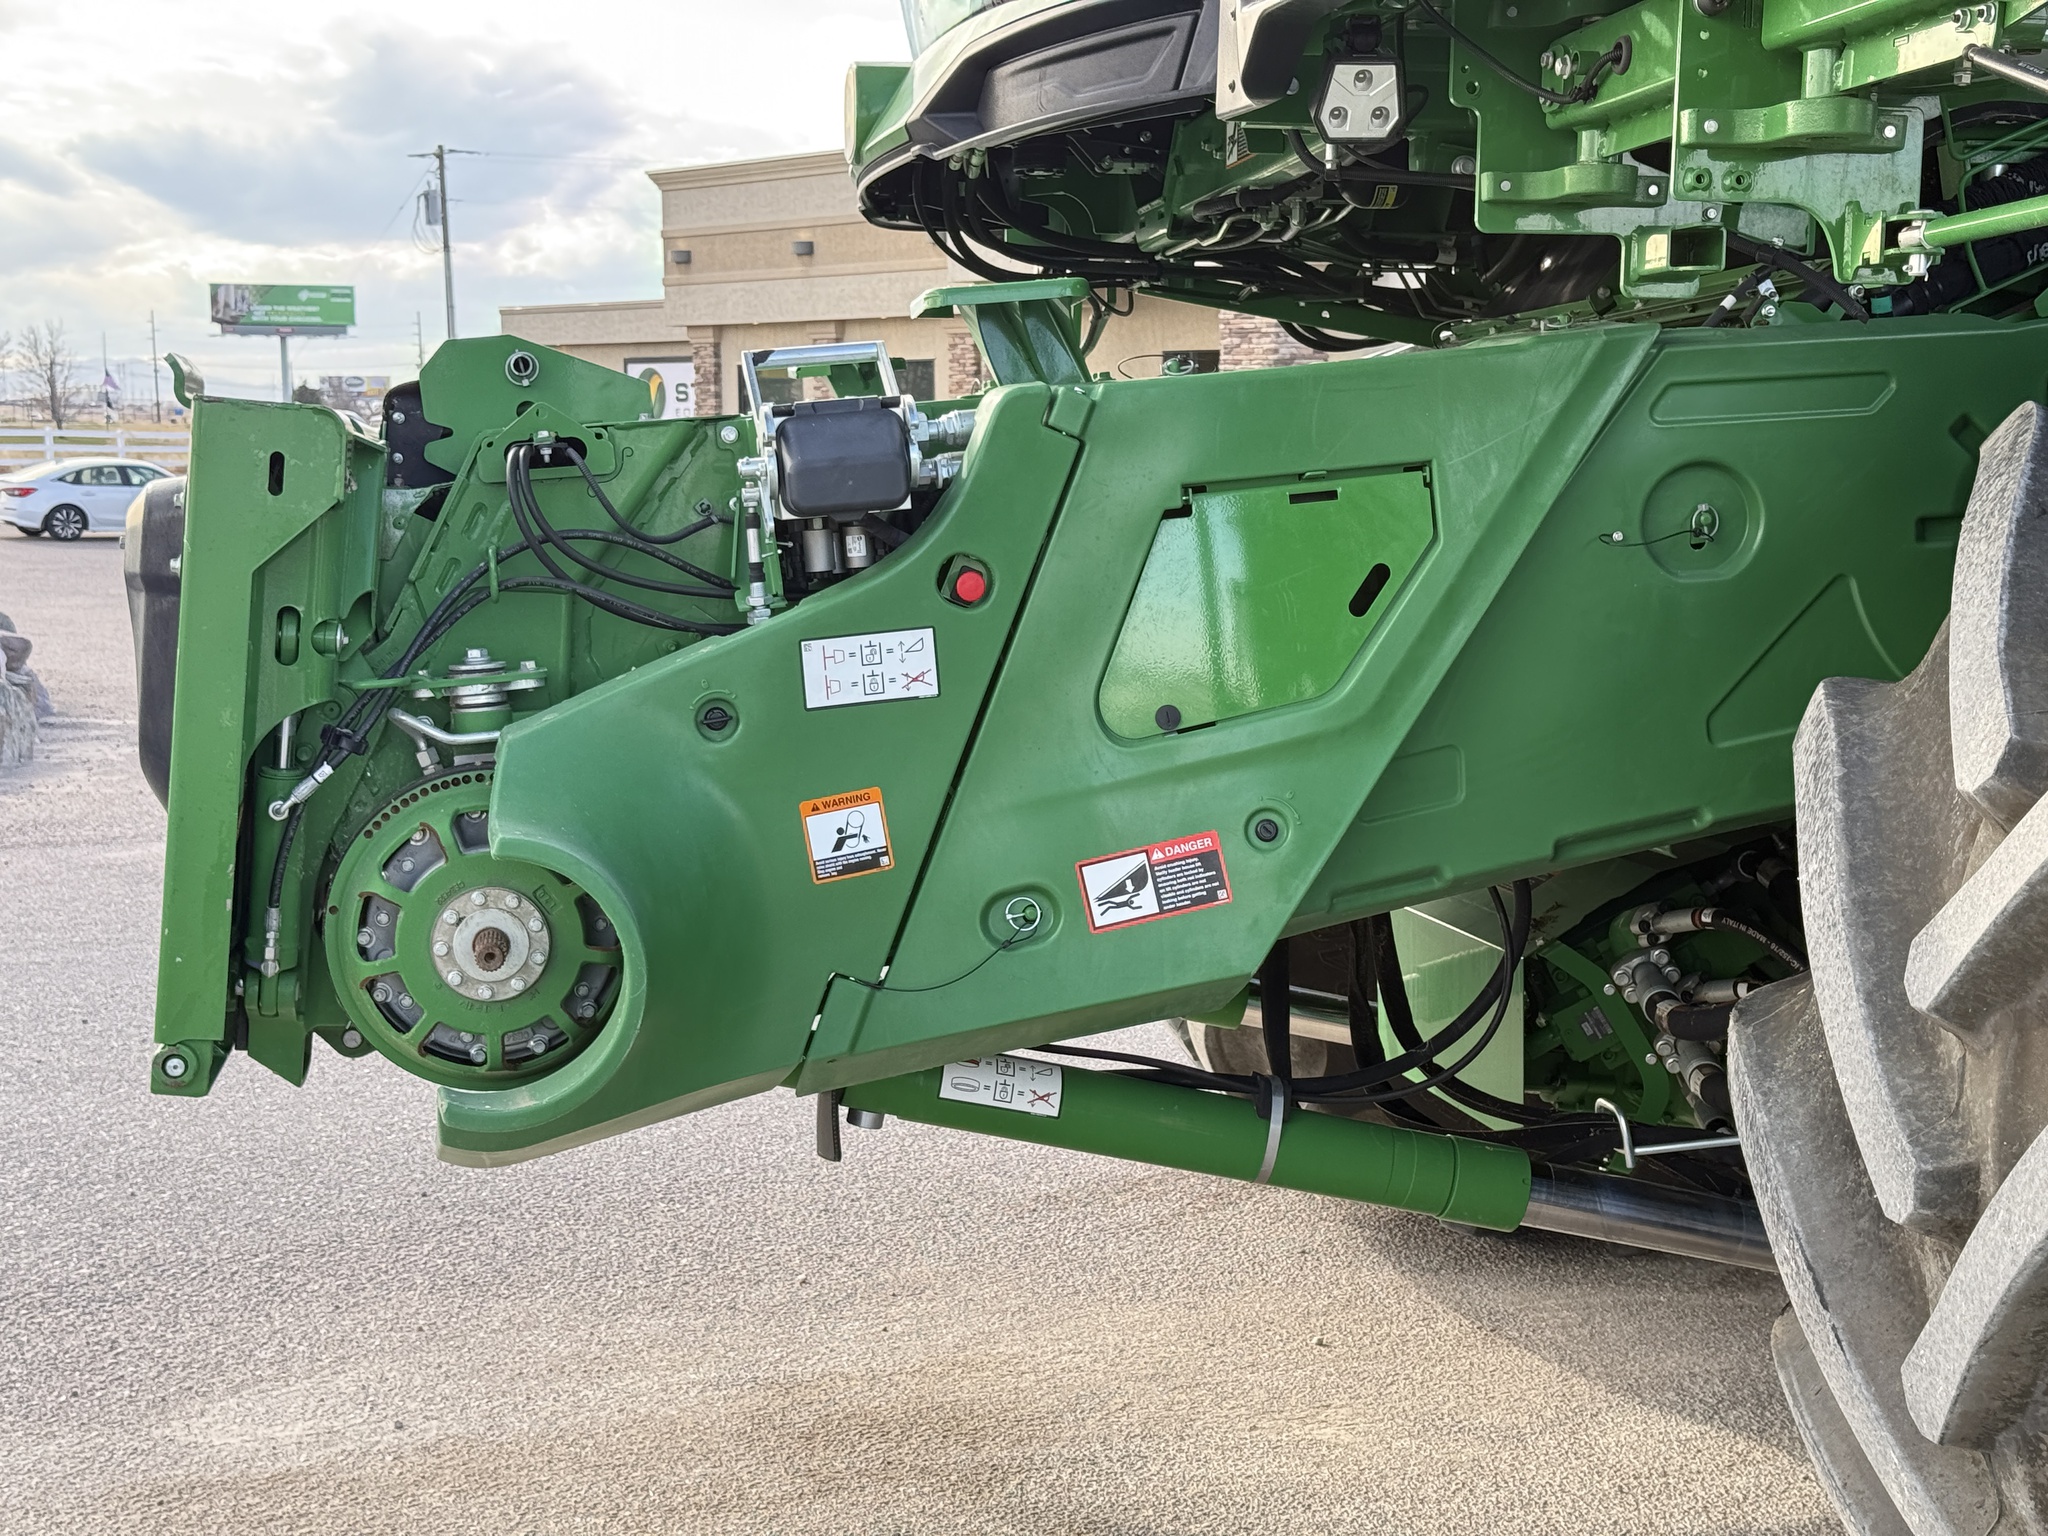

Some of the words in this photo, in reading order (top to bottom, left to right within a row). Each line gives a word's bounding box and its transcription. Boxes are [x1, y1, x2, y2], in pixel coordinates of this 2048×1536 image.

[821, 792, 871, 810] WARNING
[1164, 838, 1213, 857] DANGER
[1721, 917, 1740, 929] ITALY
[1746, 926, 1768, 943] MADE
